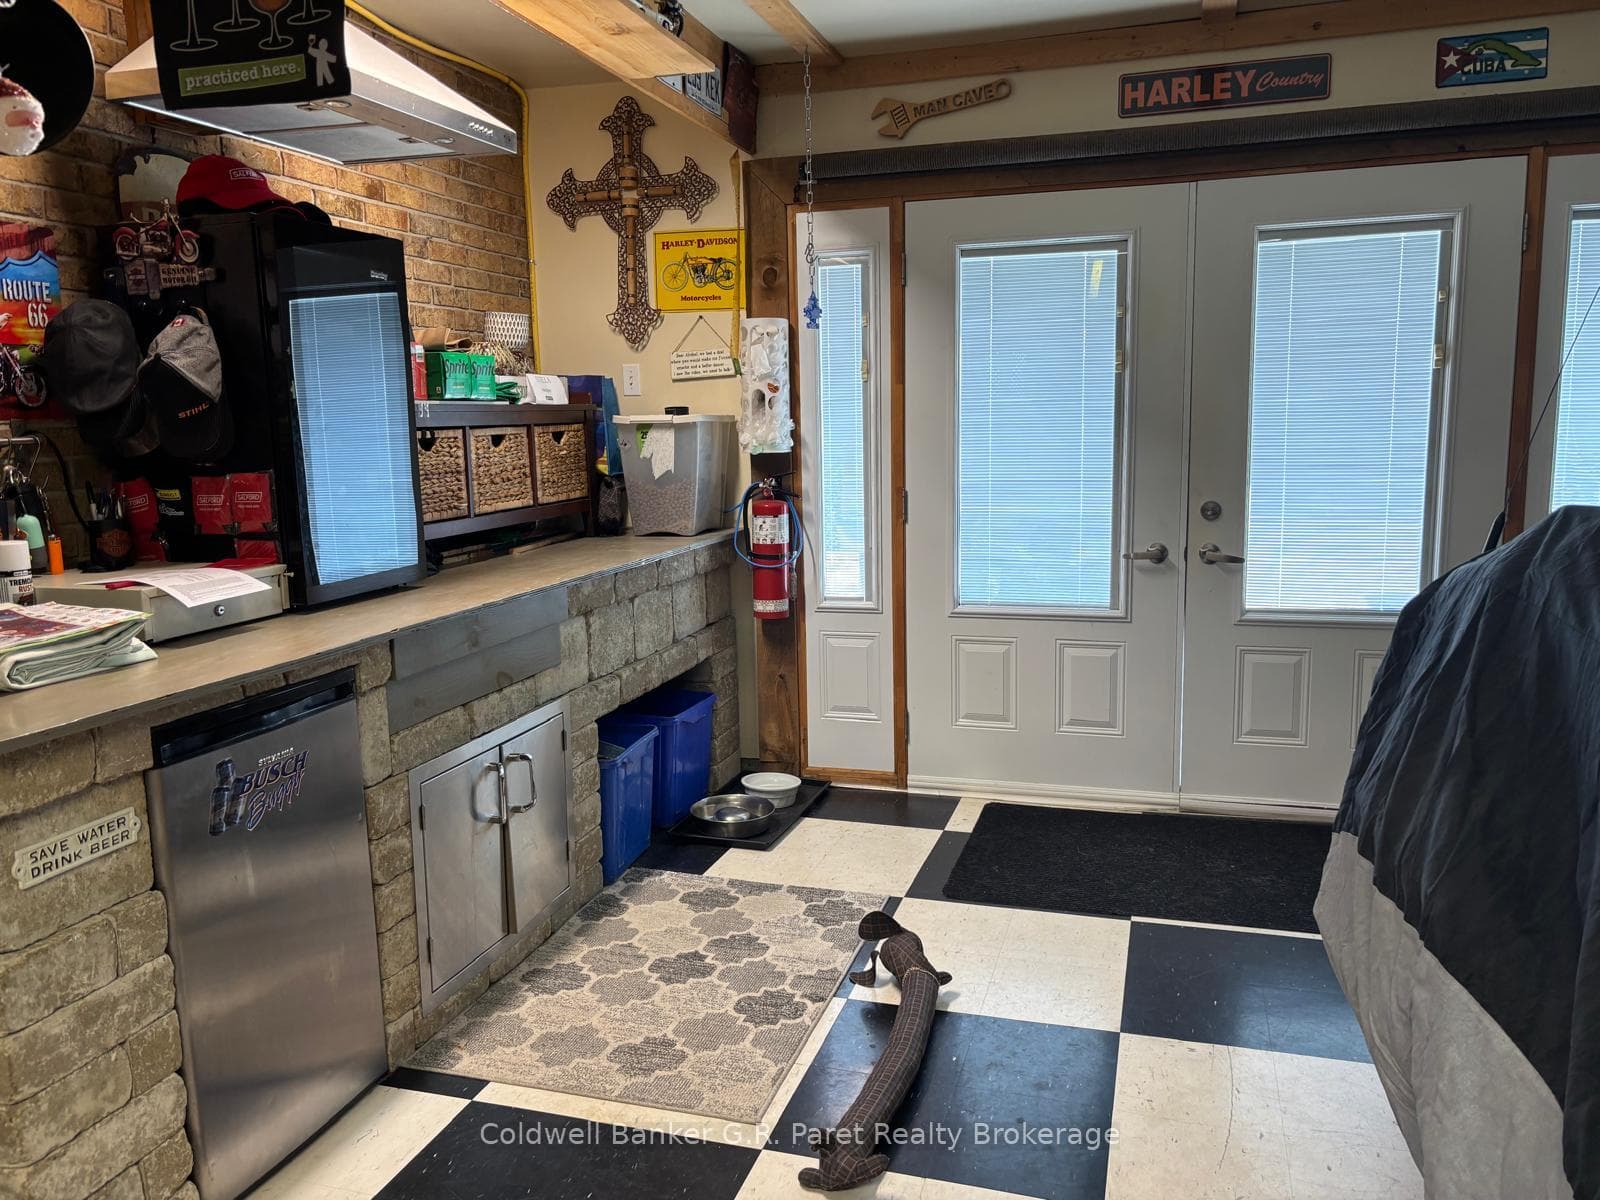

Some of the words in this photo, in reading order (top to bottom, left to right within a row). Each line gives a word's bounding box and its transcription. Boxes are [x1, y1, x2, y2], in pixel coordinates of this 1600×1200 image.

[185, 68, 259, 92] practiced
[260, 60, 302, 81] here.
[1461, 57, 1507, 75] CUBA
[912, 97, 948, 119] MAN
[952, 83, 994, 108] CAVE
[1123, 69, 1257, 110] HARLEY
[1256, 71, 1324, 93] Country
[2, 279, 52, 303] ROUTE
[680, 294, 722, 302] Motorcycles
[27, 303, 49, 328] 66
[445, 358, 469, 378] Sprite
[177, 400, 210, 419] STIHL
[239, 750, 310, 797] BUSCH
[29, 839, 69, 865] SAVE
[77, 815, 127, 844] WATER
[31, 850, 83, 880] DRINK
[90, 829, 130, 856] BEER
